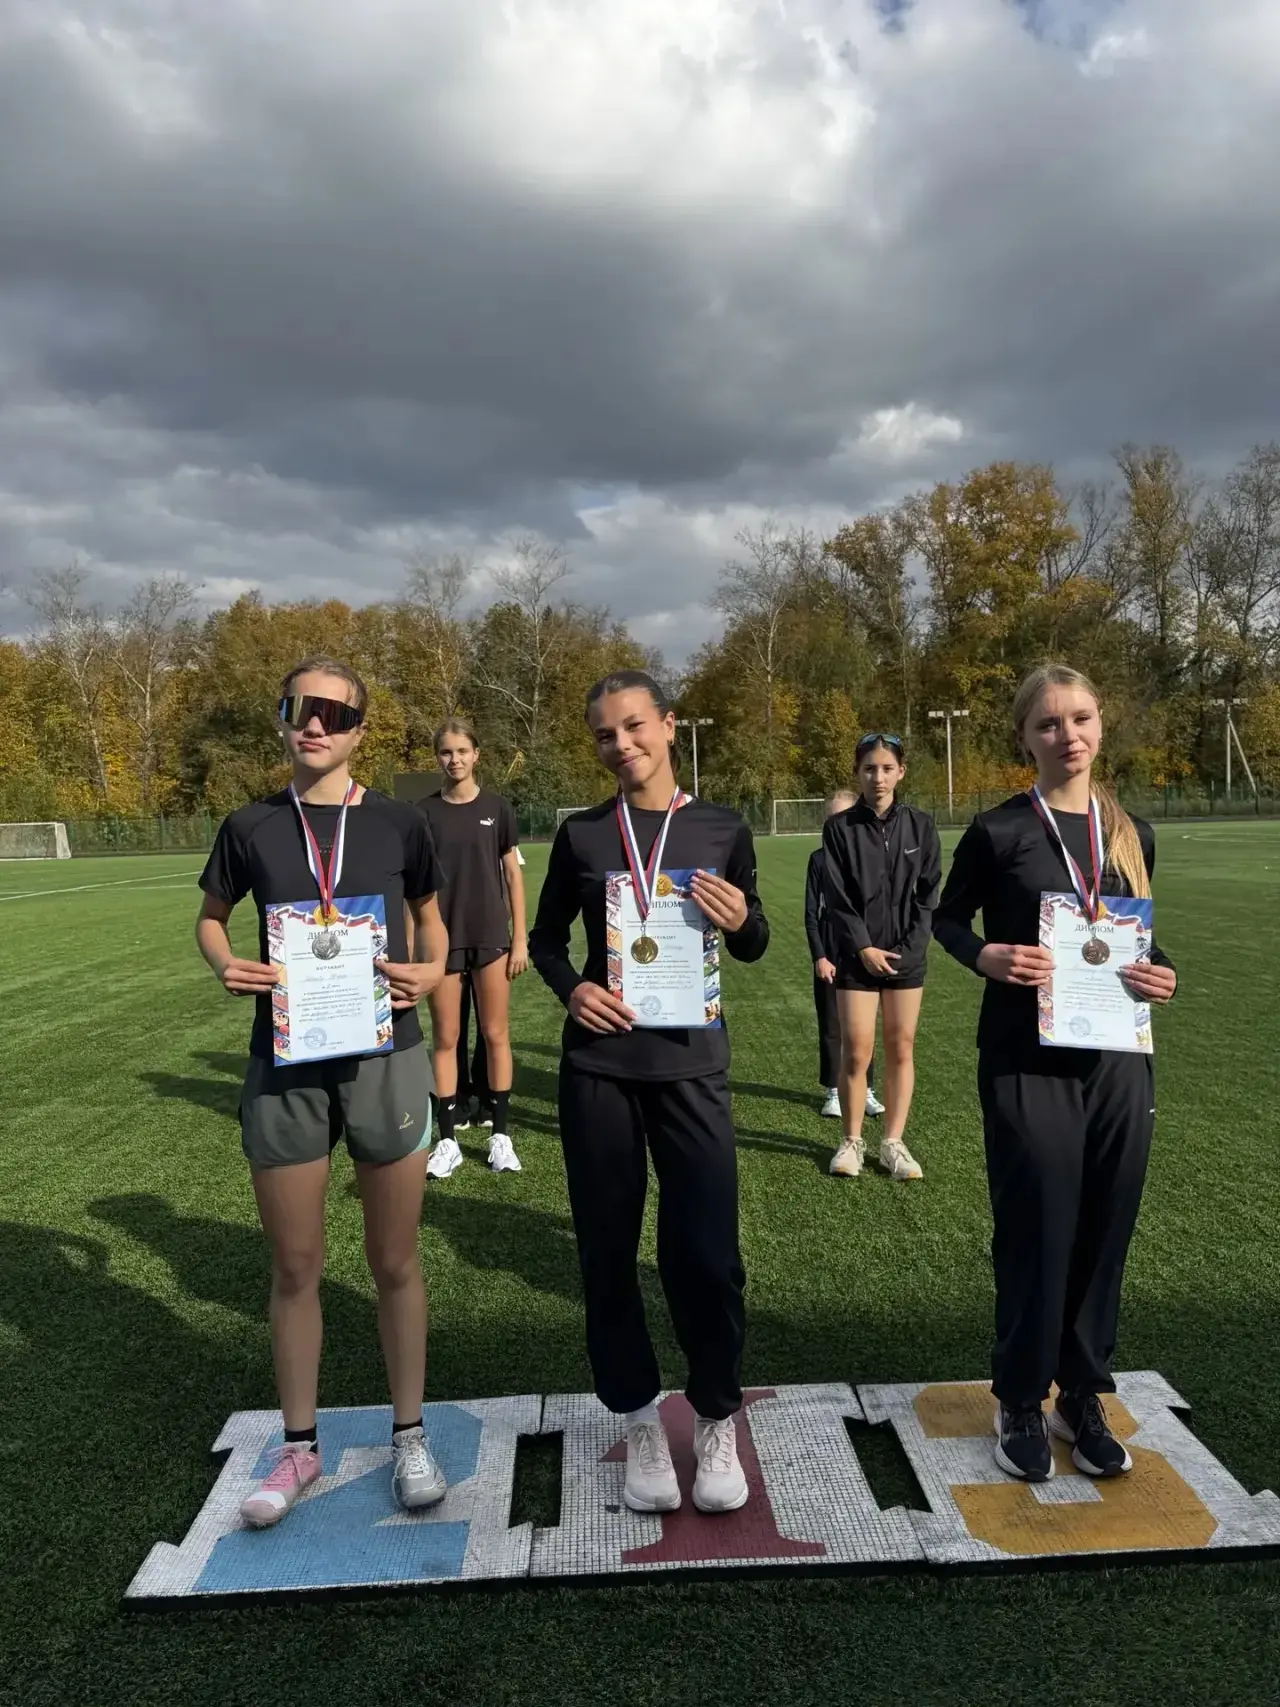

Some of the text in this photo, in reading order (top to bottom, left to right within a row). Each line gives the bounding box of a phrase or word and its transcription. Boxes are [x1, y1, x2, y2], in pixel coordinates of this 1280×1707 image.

[307, 929, 349, 941] ДИОМ
[652, 900, 681, 909] ПЛОМ
[1074, 923, 1114, 933] ДИЛОМ
[192, 1403, 483, 1592] 2
[600, 1388, 828, 1564] 1
[913, 1379, 1218, 1555] 3
